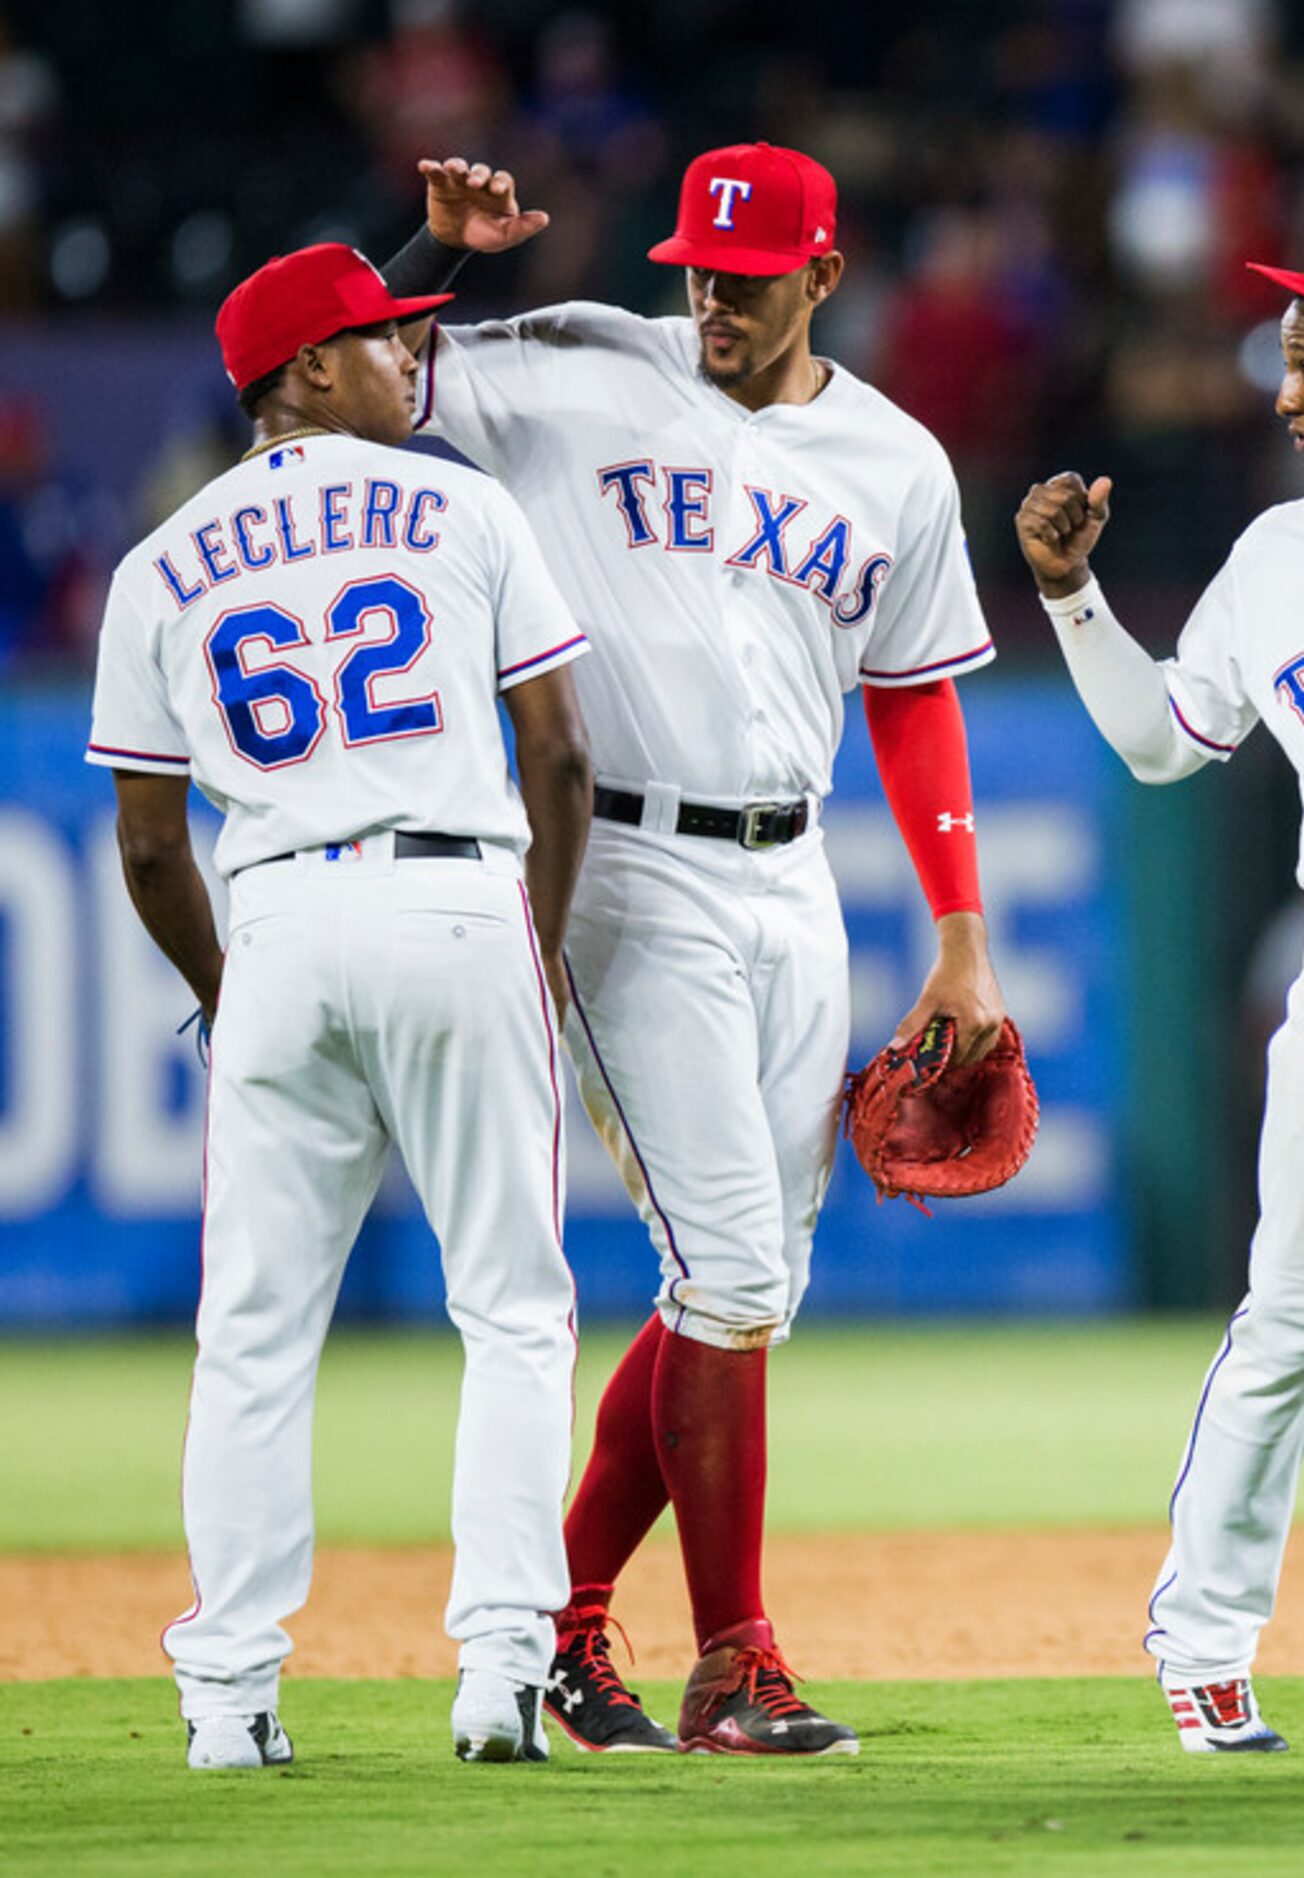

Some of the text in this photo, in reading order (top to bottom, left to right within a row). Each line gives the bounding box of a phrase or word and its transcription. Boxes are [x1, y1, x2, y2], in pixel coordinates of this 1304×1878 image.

[708, 177, 753, 231] T
[153, 479, 449, 611] LECLERC
[597, 458, 895, 629] TEXAS
[203, 572, 444, 773] 62
